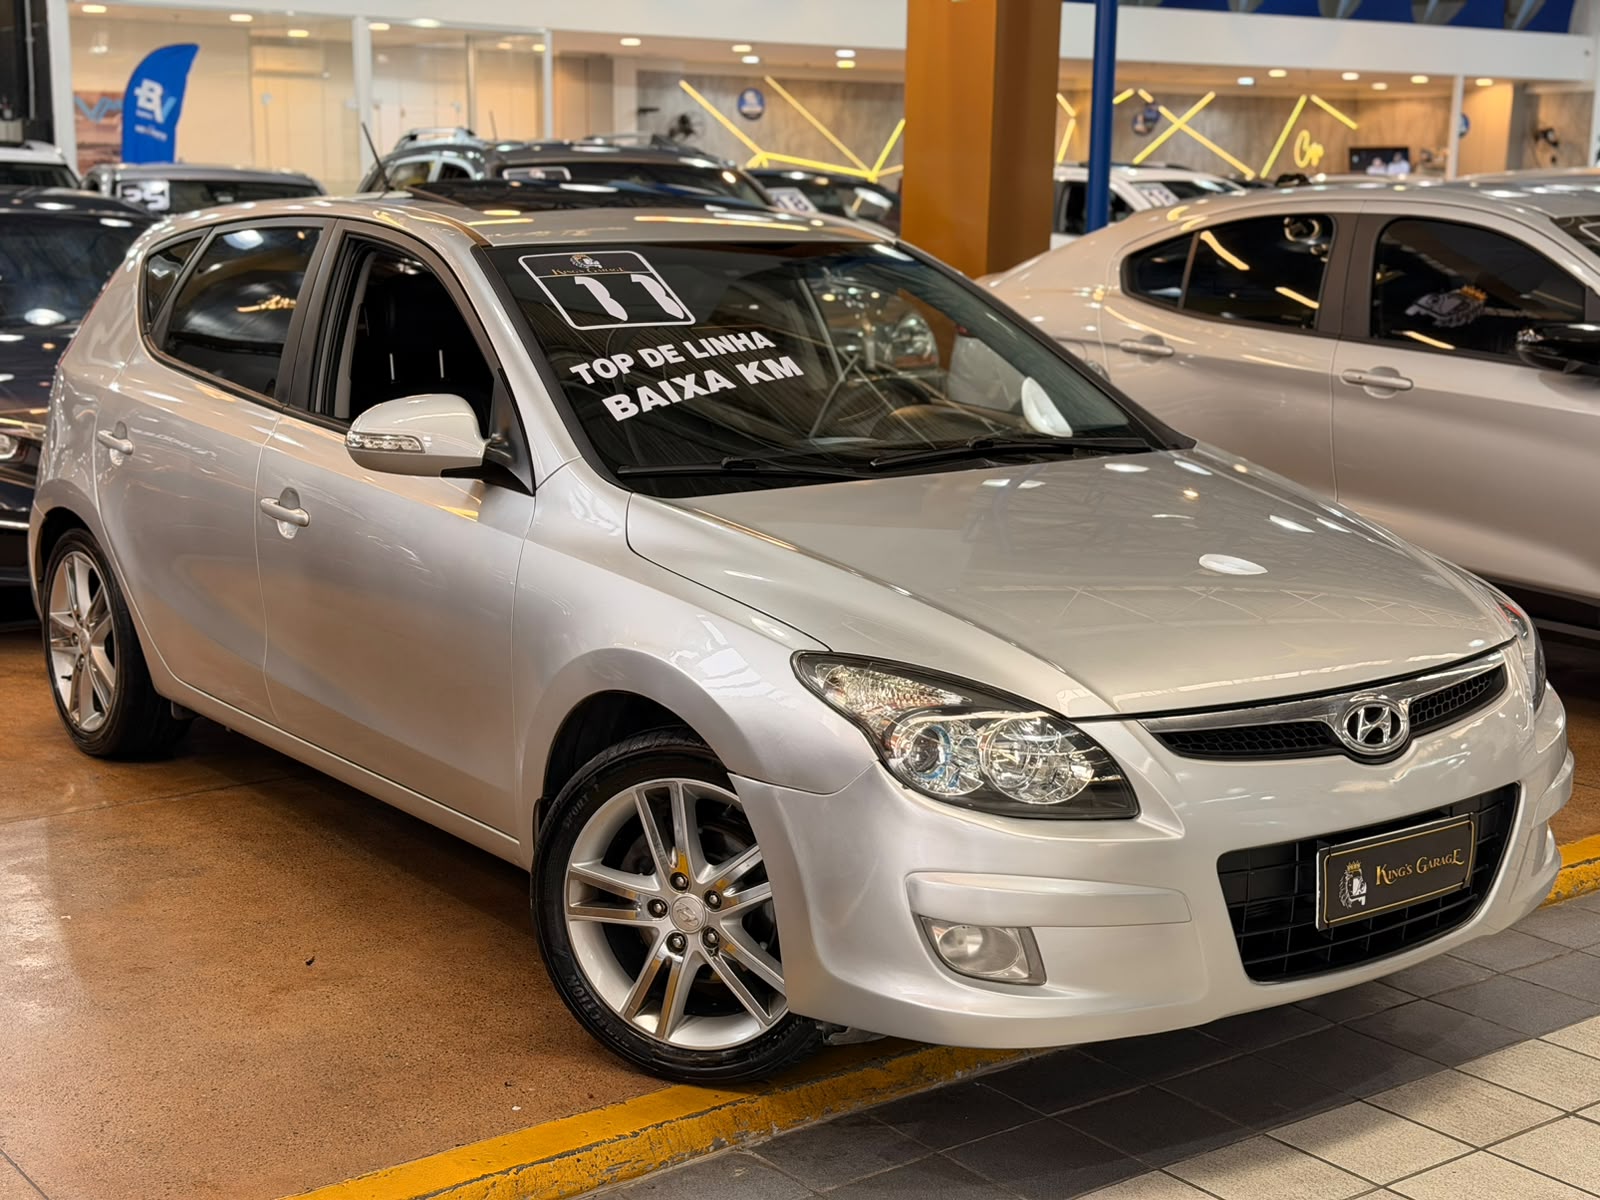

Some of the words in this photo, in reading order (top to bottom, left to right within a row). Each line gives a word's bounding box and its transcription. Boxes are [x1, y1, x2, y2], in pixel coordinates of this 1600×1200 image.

[569, 353, 635, 385] TOP
[637, 343, 686, 368] DE
[682, 331, 777, 360] LINHA
[601, 369, 737, 422] BAIXA
[735, 356, 805, 385] KM
[1375, 863, 1413, 886] KING'S
[1416, 848, 1465, 874] GARAGE
